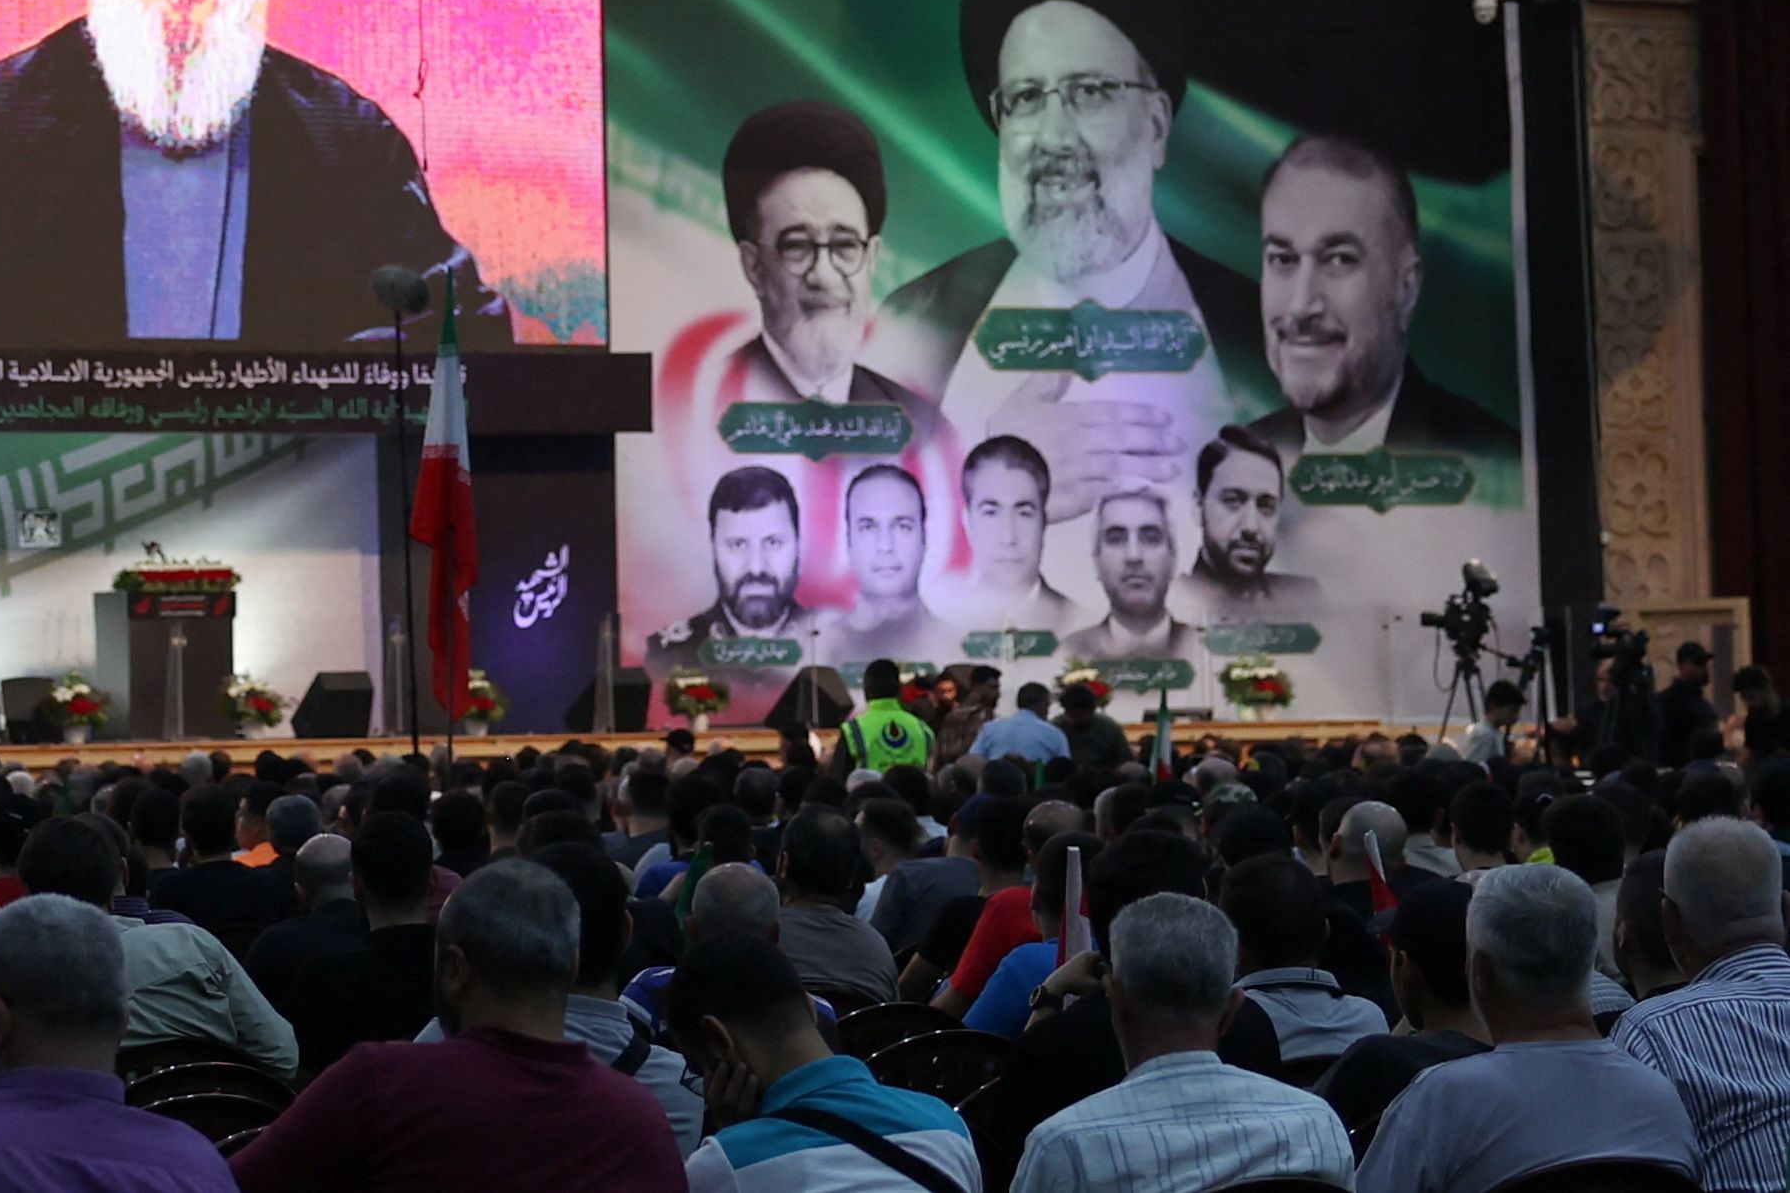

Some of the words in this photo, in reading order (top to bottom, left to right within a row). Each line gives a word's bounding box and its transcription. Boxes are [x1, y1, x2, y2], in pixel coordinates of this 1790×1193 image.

[93, 358, 174, 388] الجمهورية
[177, 358, 226, 390] رئيس
[227, 356, 287, 389] الأطهار
[292, 361, 359, 389] للشهداء
[338, 397, 368, 420] الله
